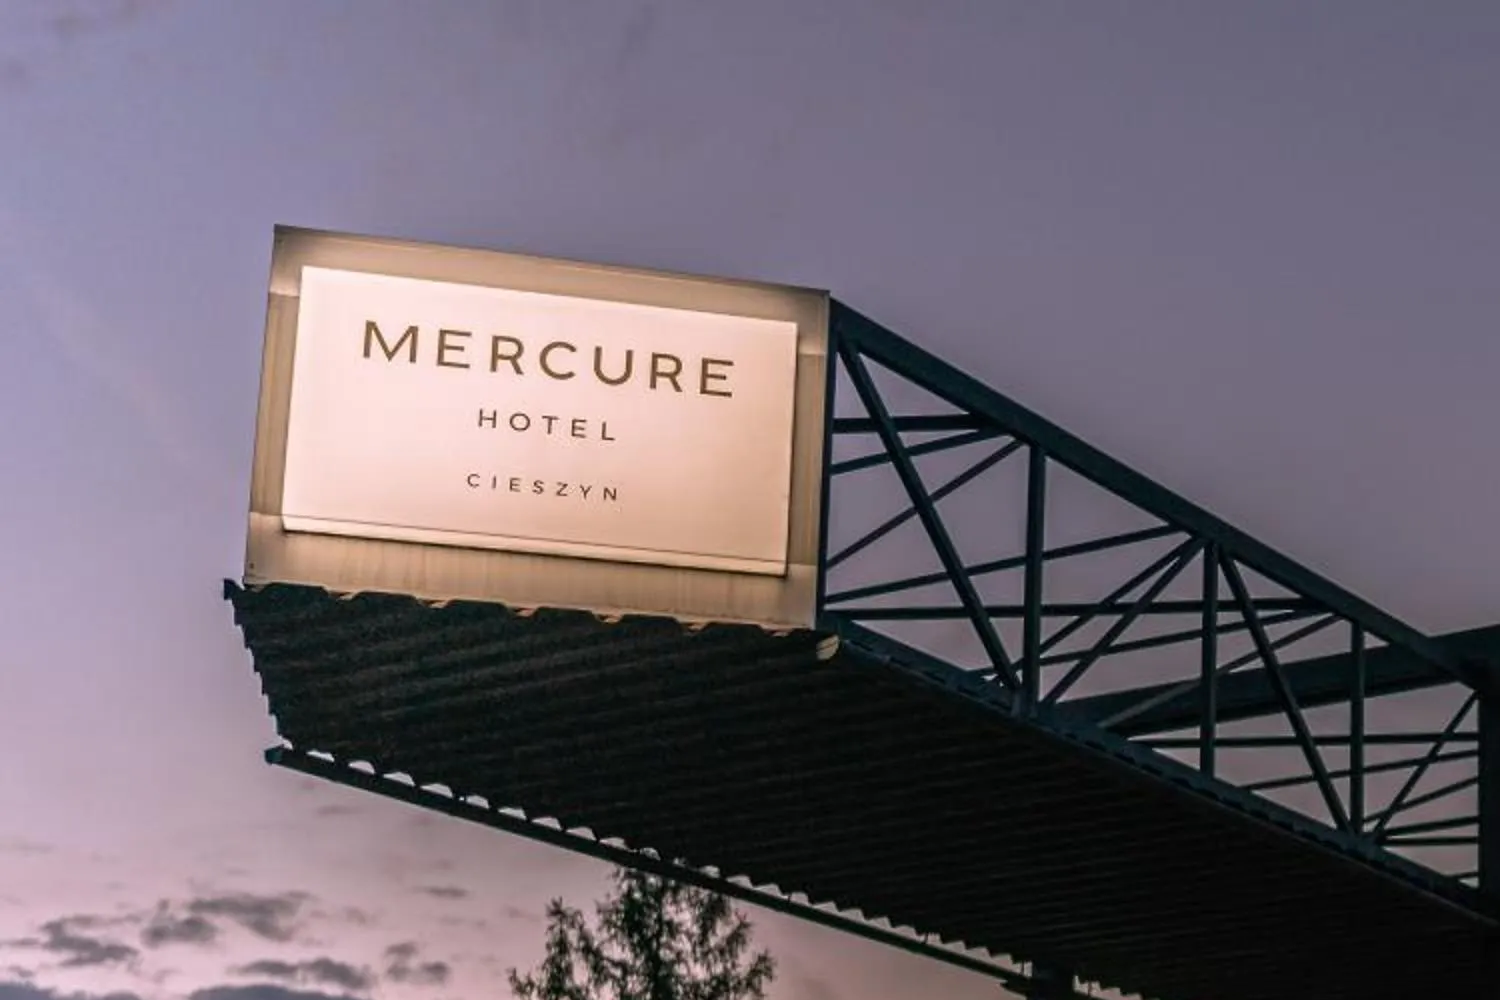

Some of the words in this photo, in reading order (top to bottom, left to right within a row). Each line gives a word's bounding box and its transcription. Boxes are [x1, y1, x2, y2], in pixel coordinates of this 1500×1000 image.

[362, 320, 735, 398] MERCURE
[477, 408, 616, 442] HOTEL
[466, 473, 619, 502] CIESZYN
